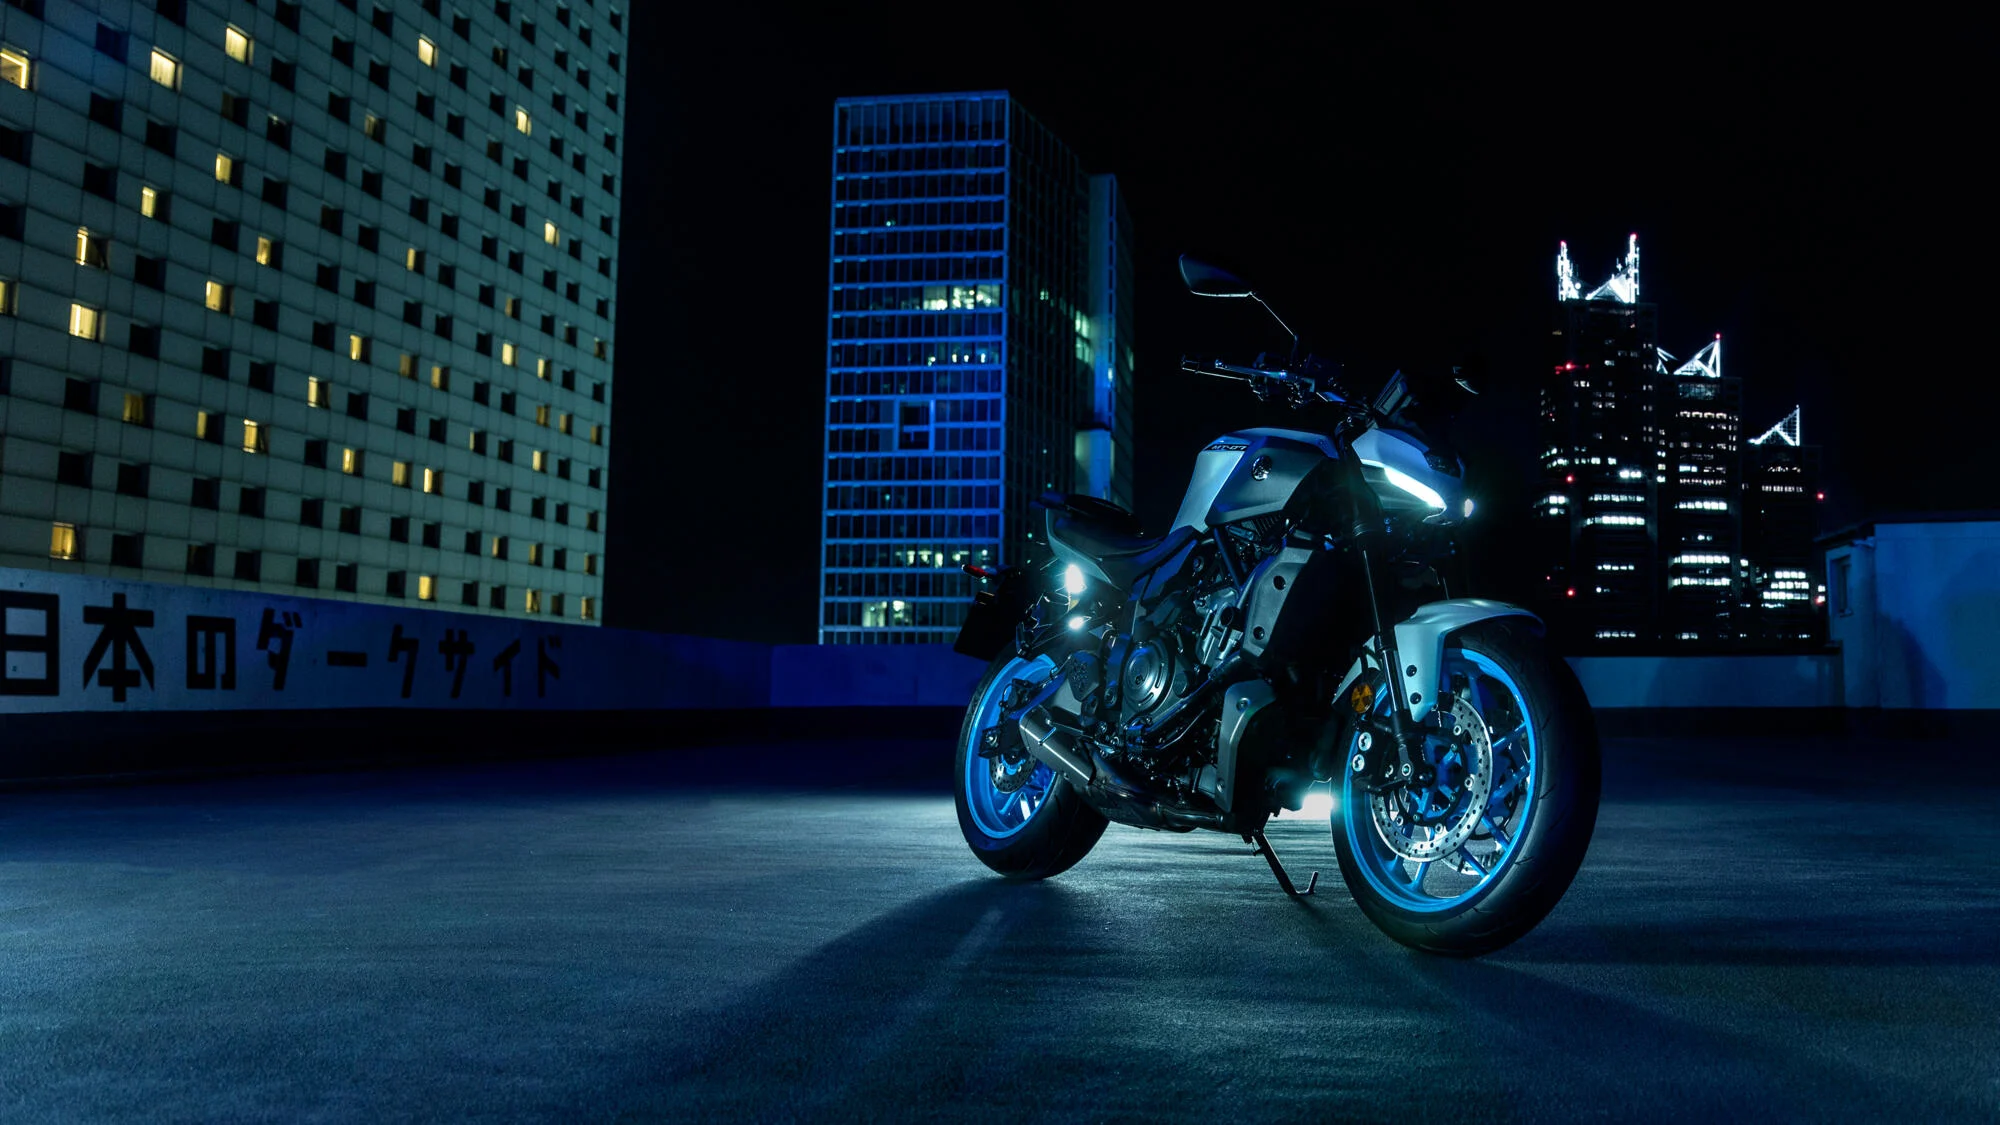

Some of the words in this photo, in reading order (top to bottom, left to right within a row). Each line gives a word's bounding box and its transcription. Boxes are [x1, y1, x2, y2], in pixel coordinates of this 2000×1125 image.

[0, 591, 561, 702] 日本のダークサイド
